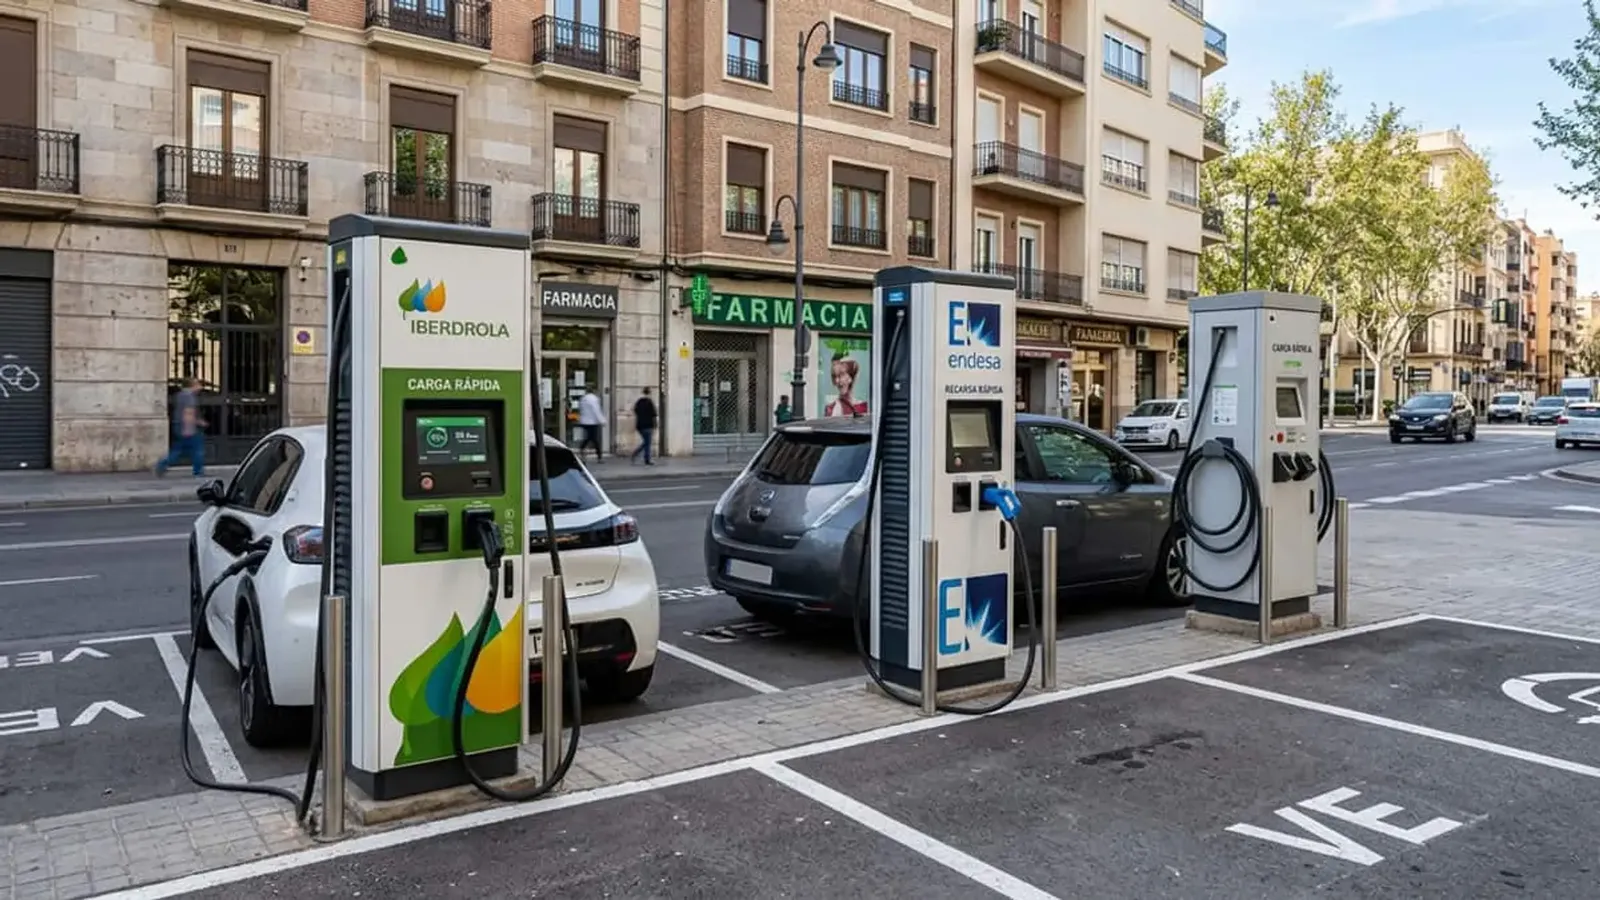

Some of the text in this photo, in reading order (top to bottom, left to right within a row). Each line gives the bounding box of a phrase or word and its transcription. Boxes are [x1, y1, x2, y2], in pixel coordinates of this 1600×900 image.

[543, 290, 616, 310] FARMACIA
[706, 295, 868, 329] FARMACIA
[410, 319, 510, 338] IBERDROLA
[948, 352, 1001, 370] endesa
[407, 376, 501, 391] CARGA RÁPIDA
[1223, 786, 1464, 866] VE
